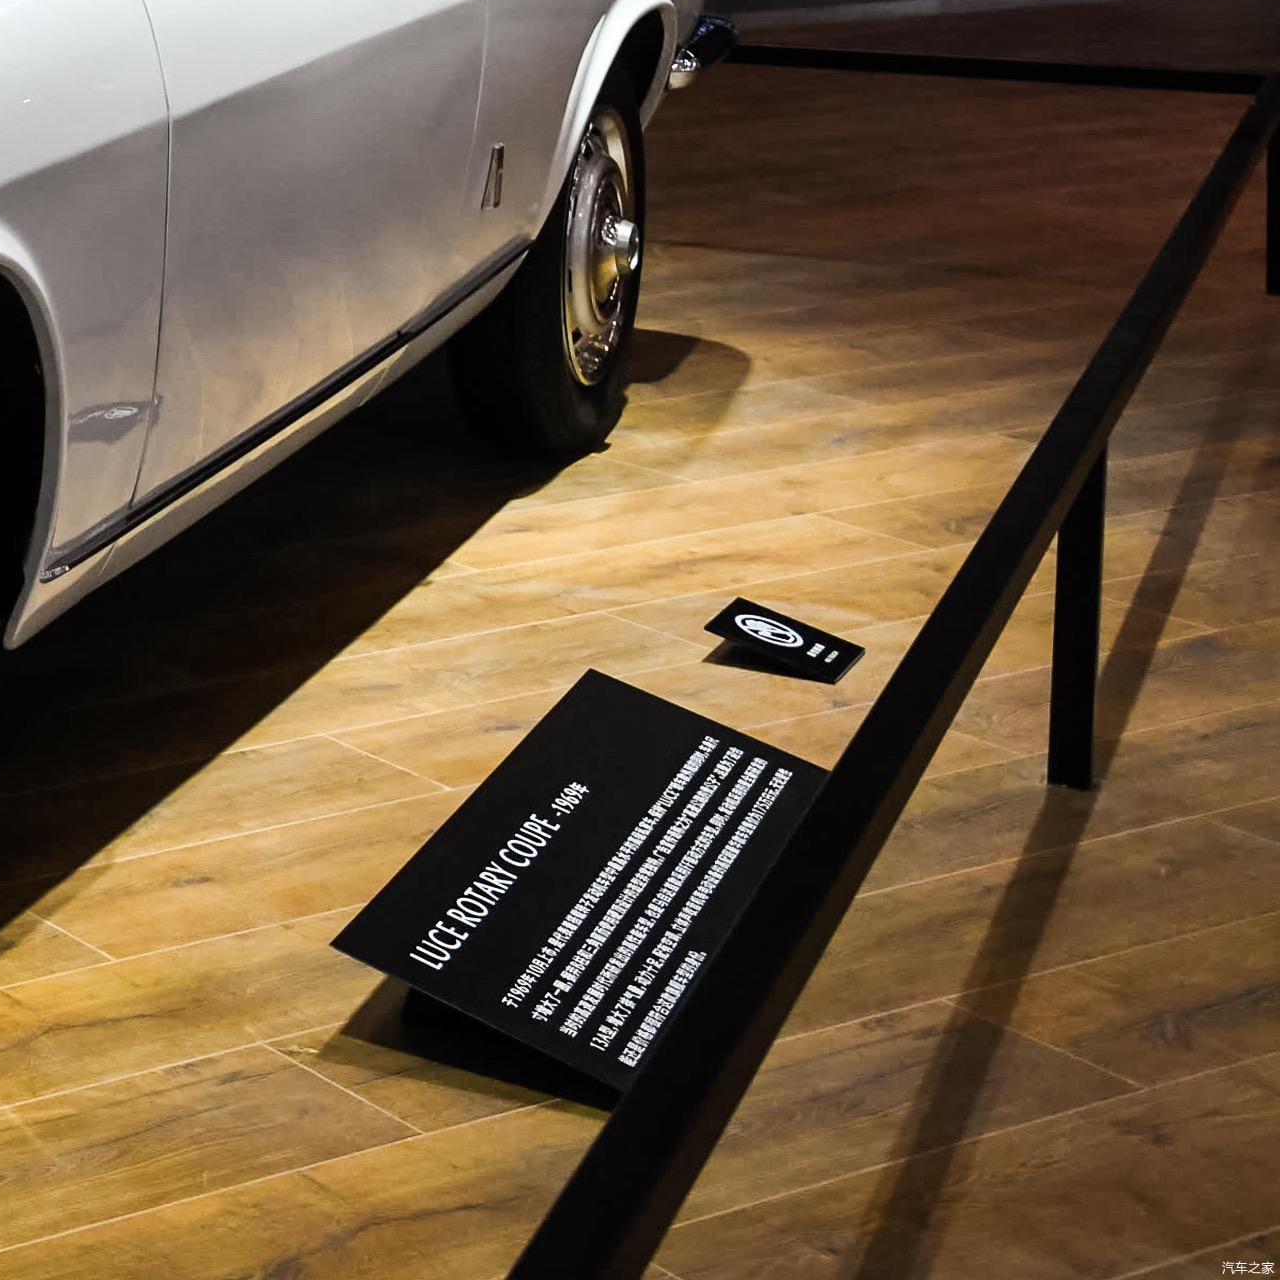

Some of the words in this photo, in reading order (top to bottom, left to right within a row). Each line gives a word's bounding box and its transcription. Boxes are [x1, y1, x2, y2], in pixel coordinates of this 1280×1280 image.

[409, 920, 470, 971] LUCE
[446, 860, 518, 928] ROTARY
[498, 813, 561, 868] COUPE
